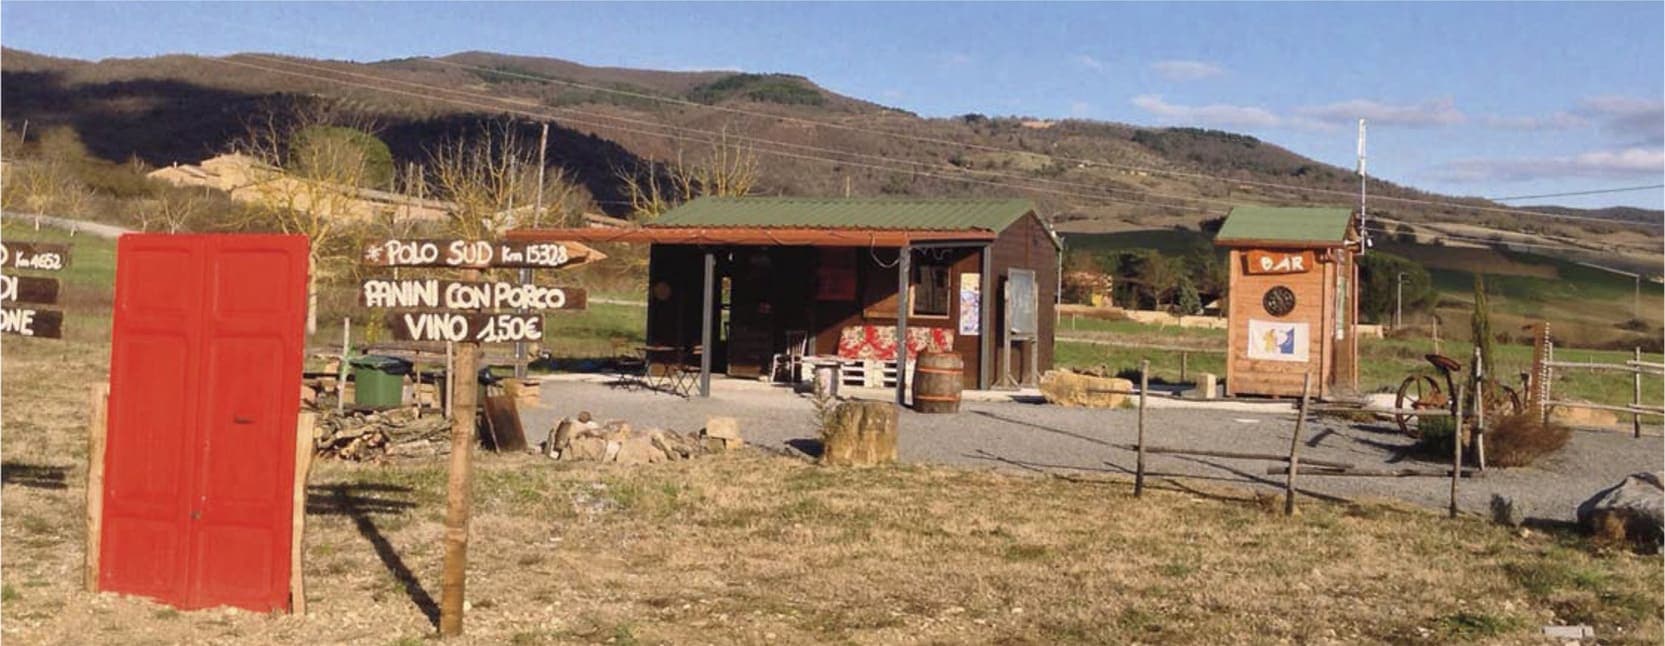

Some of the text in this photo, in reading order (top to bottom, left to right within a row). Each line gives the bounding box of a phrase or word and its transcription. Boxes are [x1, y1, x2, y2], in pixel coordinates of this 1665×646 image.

[31, 252, 62, 270] 4652
[385, 240, 569, 266] POLO SUD Km 15328
[1260, 255, 1305, 271] BAR
[364, 279, 566, 309] PANINI CON PORCO
[404, 314, 468, 341] VINO
